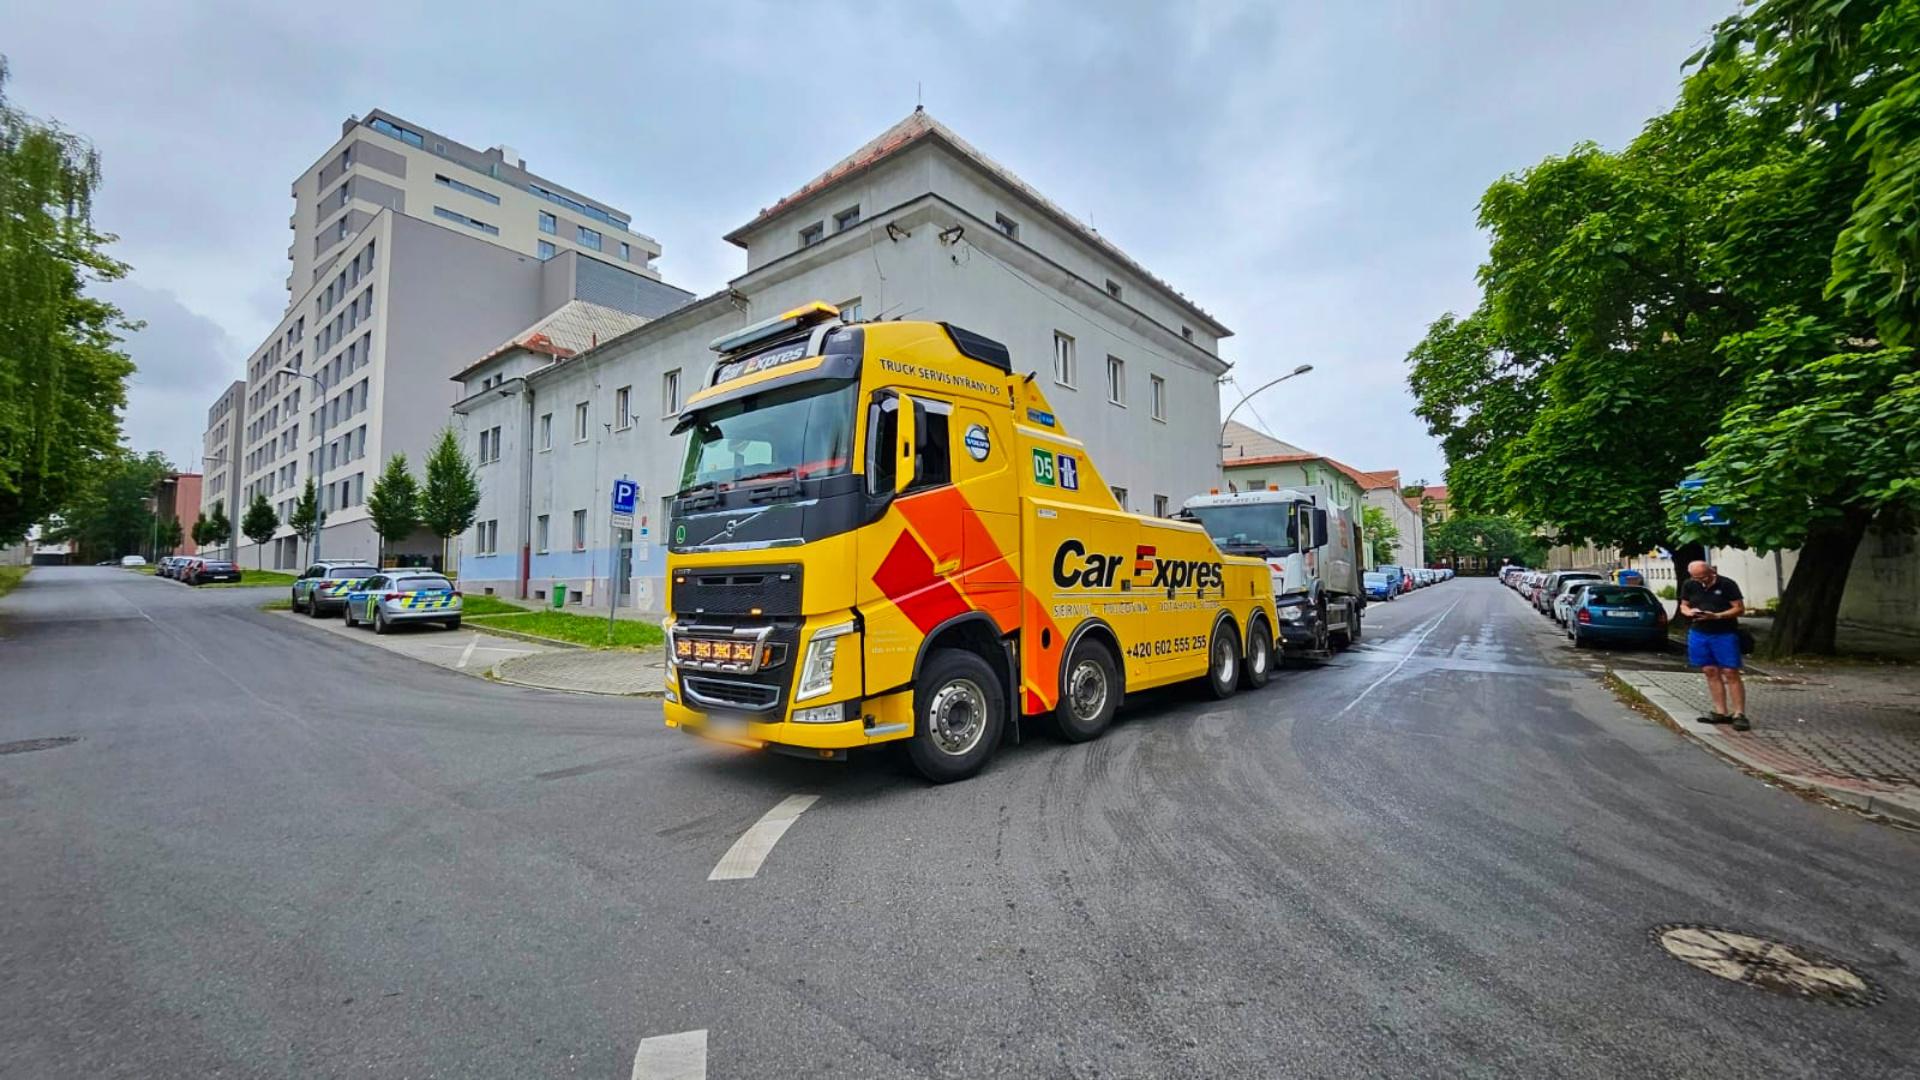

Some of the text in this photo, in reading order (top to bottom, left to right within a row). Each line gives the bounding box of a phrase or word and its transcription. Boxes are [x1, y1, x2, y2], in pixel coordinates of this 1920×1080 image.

[880, 358, 915, 376] TRUCK
[919, 367, 951, 385] SERVIS
[1034, 454, 1054, 480] D5
[617, 484, 632, 504] P
[1053, 540, 1223, 588] Car Expres
[1127, 634, 1207, 659] +420 602 555 255
